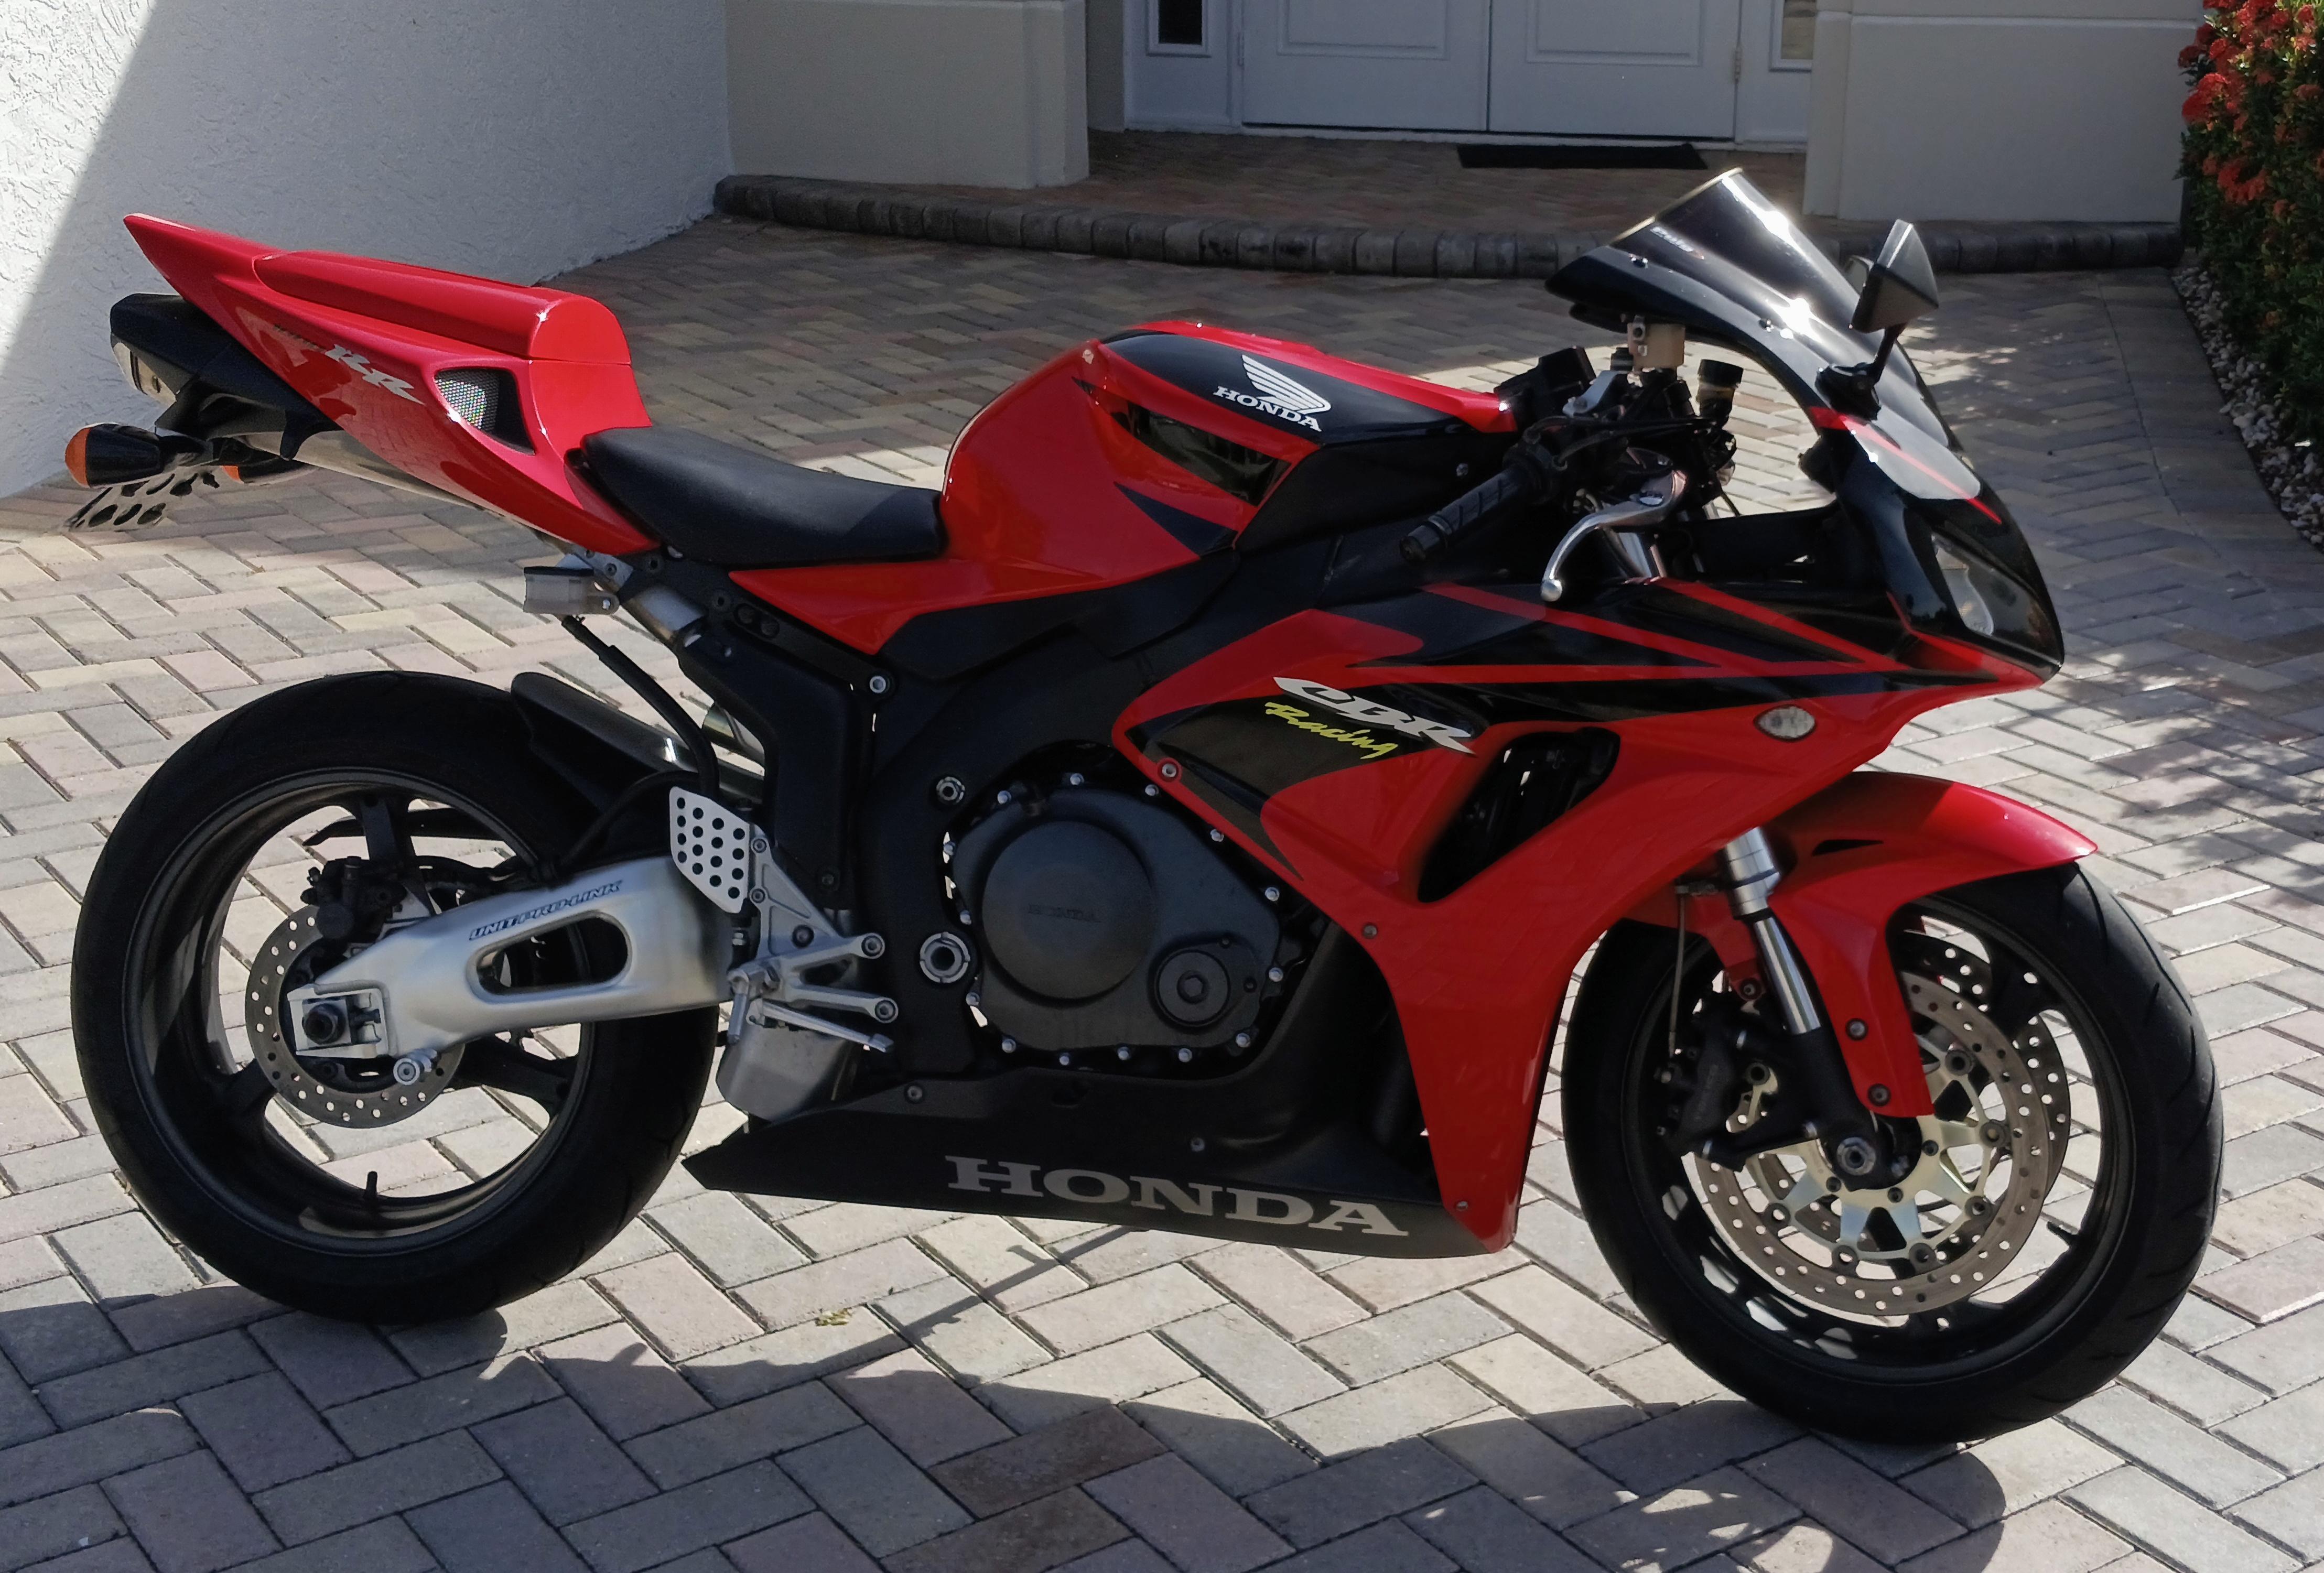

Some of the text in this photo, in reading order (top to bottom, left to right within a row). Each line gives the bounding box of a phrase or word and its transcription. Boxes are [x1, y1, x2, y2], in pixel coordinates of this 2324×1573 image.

[1213, 385, 1322, 432] HONDA
[1264, 701, 1399, 760] Racing
[1273, 676, 1478, 757] CBR
[945, 1155, 1409, 1237] HONDA
